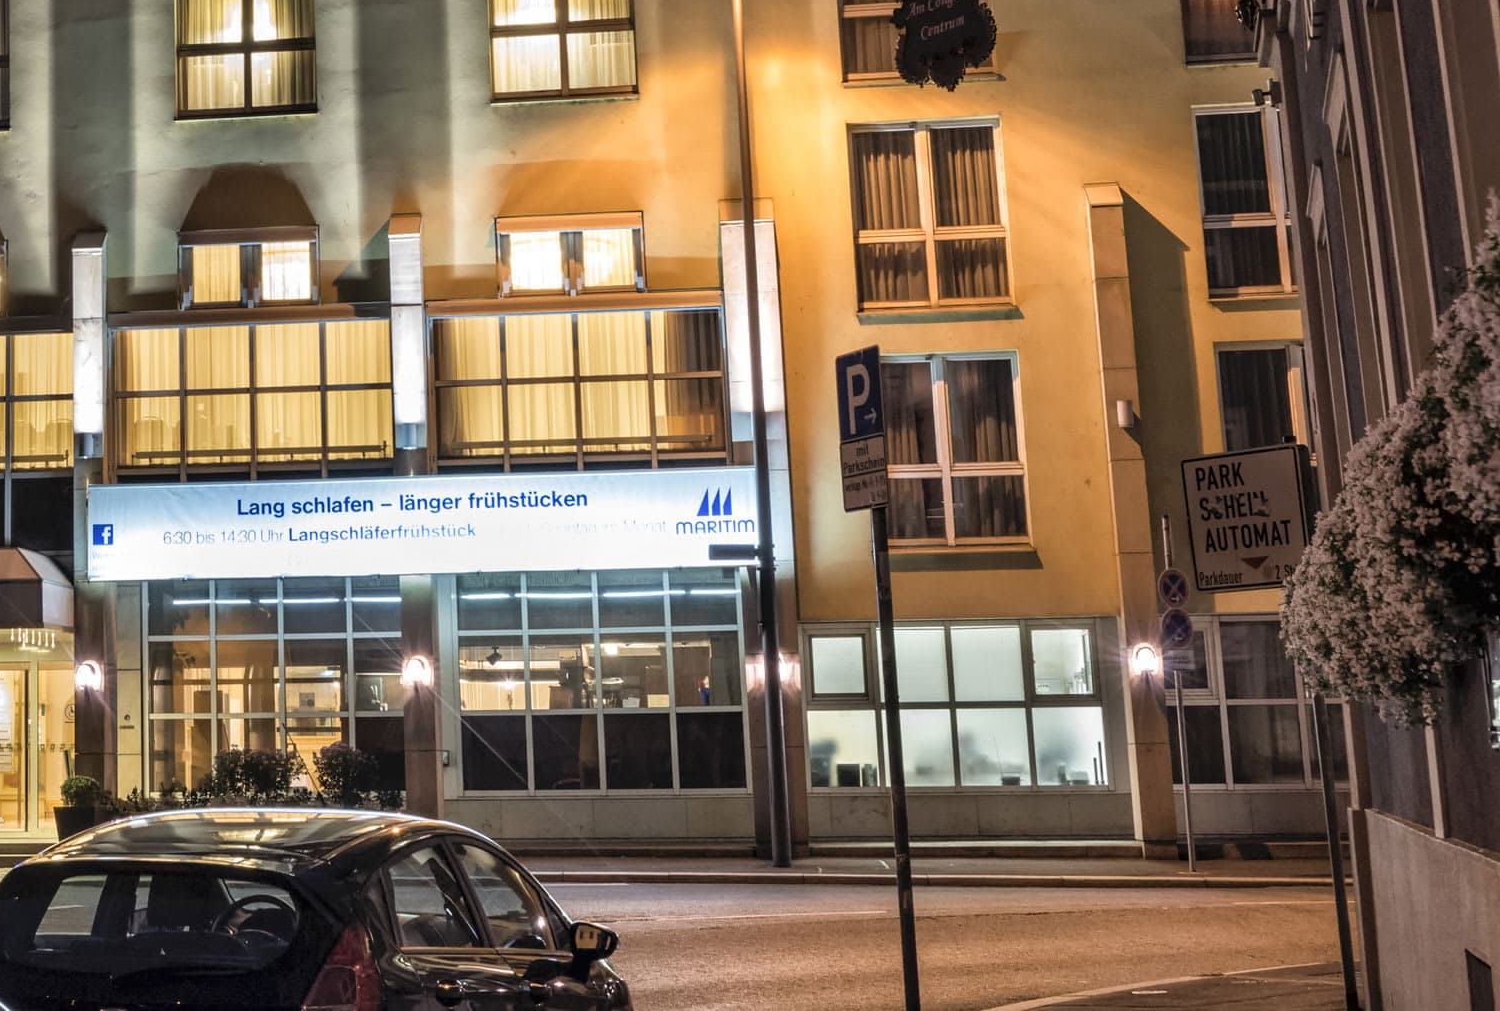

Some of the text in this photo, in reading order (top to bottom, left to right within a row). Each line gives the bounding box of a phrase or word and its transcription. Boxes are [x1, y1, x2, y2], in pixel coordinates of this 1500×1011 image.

[908, 2, 925, 18] Am
[920, 15, 965, 41] Centrum
[846, 363, 871, 435] P
[1195, 461, 1245, 491] PARK
[237, 498, 285, 518] Lang
[291, 495, 374, 514] schlafen
[399, 493, 462, 514] länger
[468, 490, 588, 509] frühstücken
[196, 530, 215, 544] bis
[260, 529, 283, 543] Uhr
[288, 523, 476, 544] Langschläferfrühstück
[675, 519, 755, 535] MARITIM
[1205, 519, 1291, 554] AUTOMAT
[1199, 570, 1243, 586] Parkdauer
